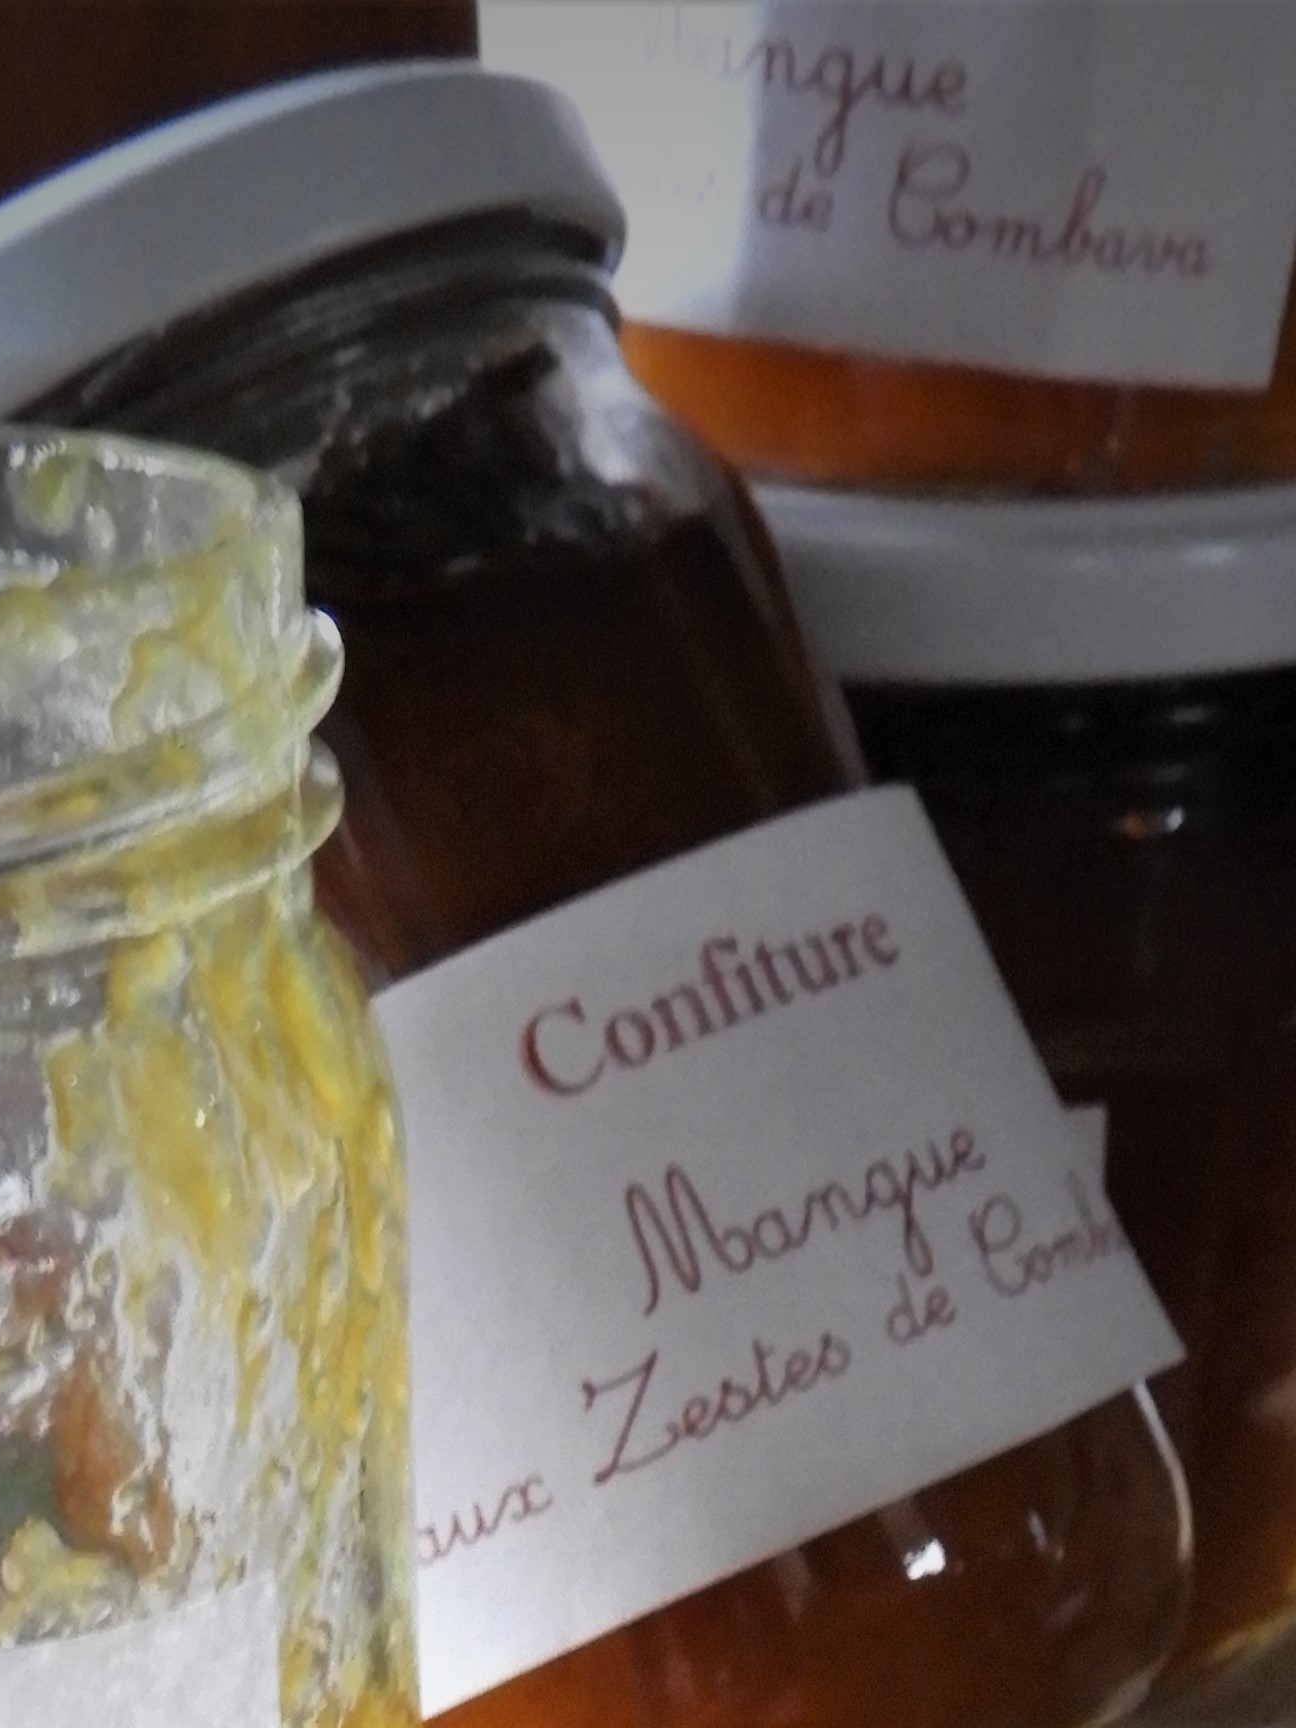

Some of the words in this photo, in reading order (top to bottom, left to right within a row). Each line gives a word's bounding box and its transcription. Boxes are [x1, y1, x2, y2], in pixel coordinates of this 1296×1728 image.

[758, 156, 836, 233] de
[888, 141, 1212, 280] Combava
[519, 912, 901, 1099] Confiture
[624, 1124, 988, 1318] Mangue
[581, 1332, 853, 1486] Zestes
[886, 1280, 957, 1350] de
